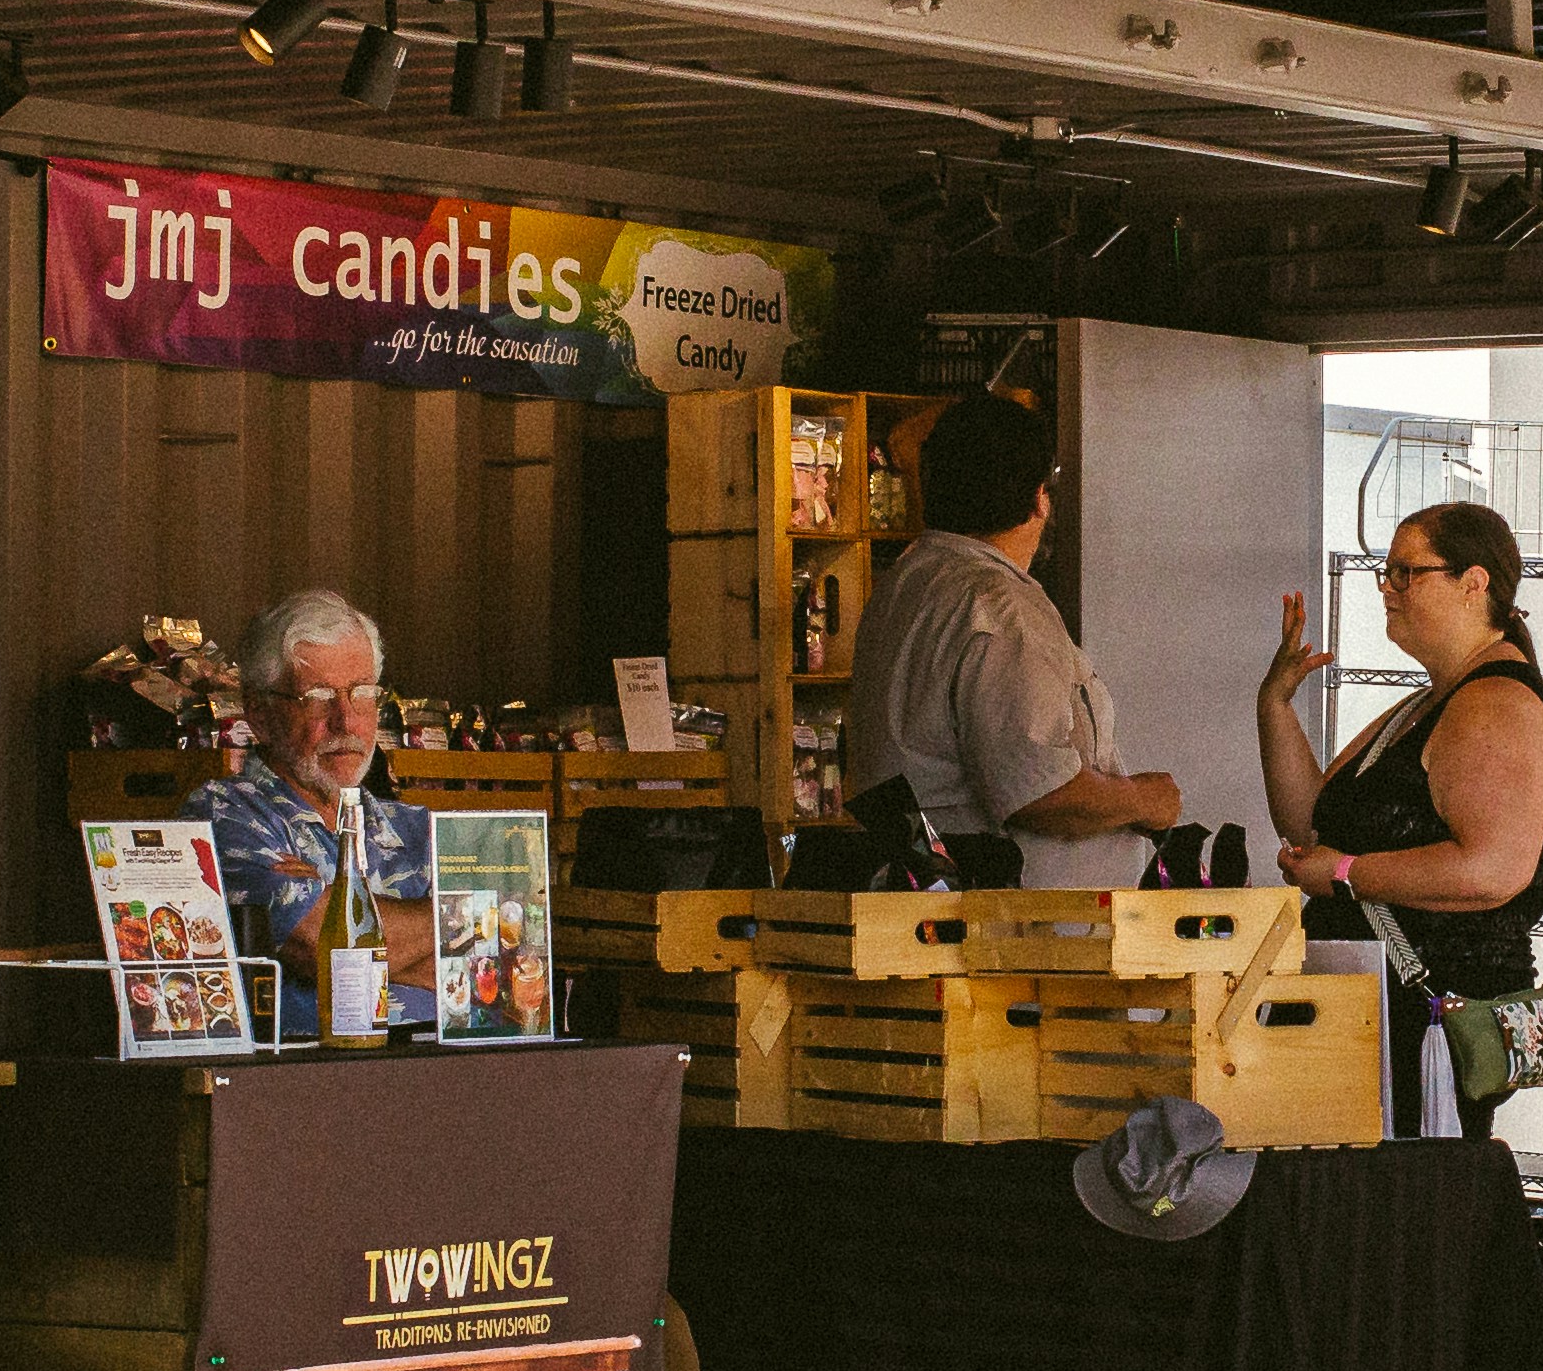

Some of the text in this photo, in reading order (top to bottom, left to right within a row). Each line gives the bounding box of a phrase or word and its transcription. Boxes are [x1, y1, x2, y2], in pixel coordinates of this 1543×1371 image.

[105, 178, 582, 324] jmj candies
[642, 274, 782, 325] Freeze Dried
[415, 321, 452, 363] for
[456, 325, 486, 357] the
[490, 335, 580, 366] sensation
[676, 333, 748, 382] Candy
[157, 848, 183, 859] Recipes
[364, 1236, 554, 1304] TWOWINGZ
[375, 1314, 551, 1350] TRADITIONS RE-ENVISIONED
